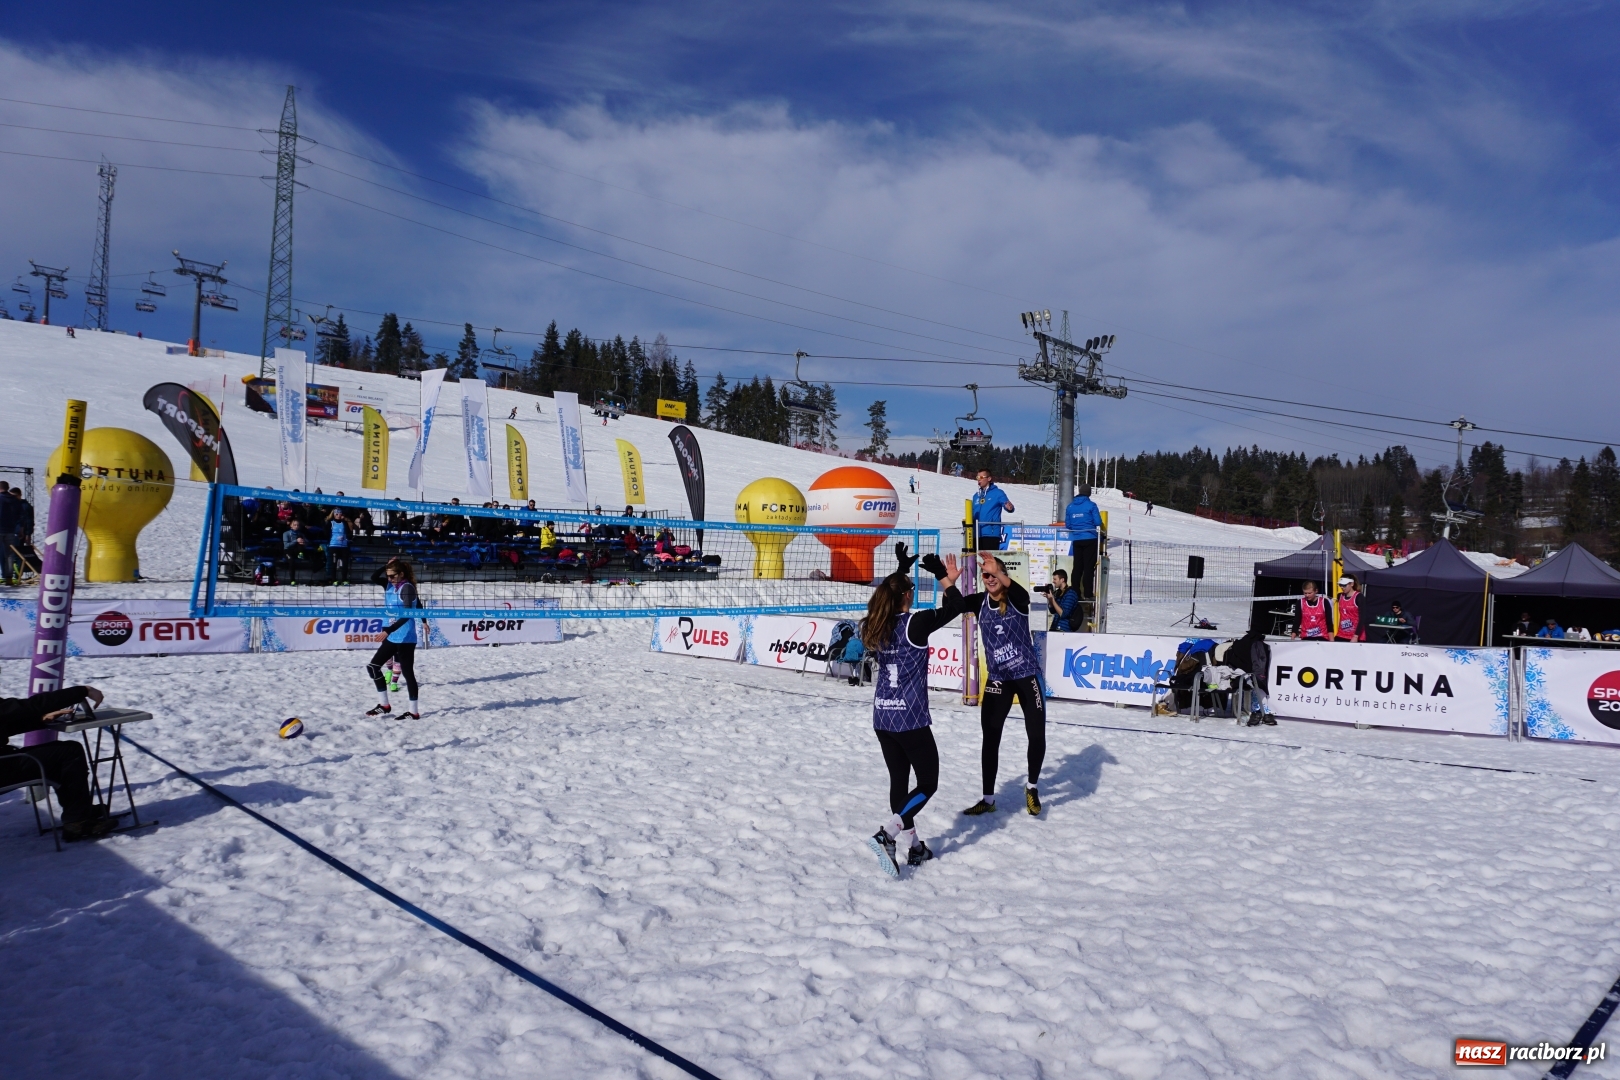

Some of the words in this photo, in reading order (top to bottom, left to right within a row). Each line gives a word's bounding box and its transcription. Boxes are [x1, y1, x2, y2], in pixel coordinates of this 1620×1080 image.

[67, 416, 76, 454] SPORT
[127, 484, 160, 493] online
[854, 494, 897, 512] Terma
[44, 574, 70, 629] BDB
[139, 618, 210, 641] rent
[304, 618, 383, 636] Terma
[462, 620, 524, 632] rhSPORT
[678, 616, 729, 650] RULES
[994, 625, 1005, 635] 2
[769, 639, 825, 655] rhSPORT
[929, 646, 958, 662] POL
[993, 642, 1013, 658] SNOW
[994, 648, 1018, 664] VOLLEY
[32, 639, 62, 692] EVE
[927, 663, 964, 678] SIATKÓ
[886, 664, 898, 687] 1
[1276, 665, 1454, 697] FORTUNA
[1277, 693, 1328, 706] zakłady
[1336, 696, 1447, 713] bukmacherskie
